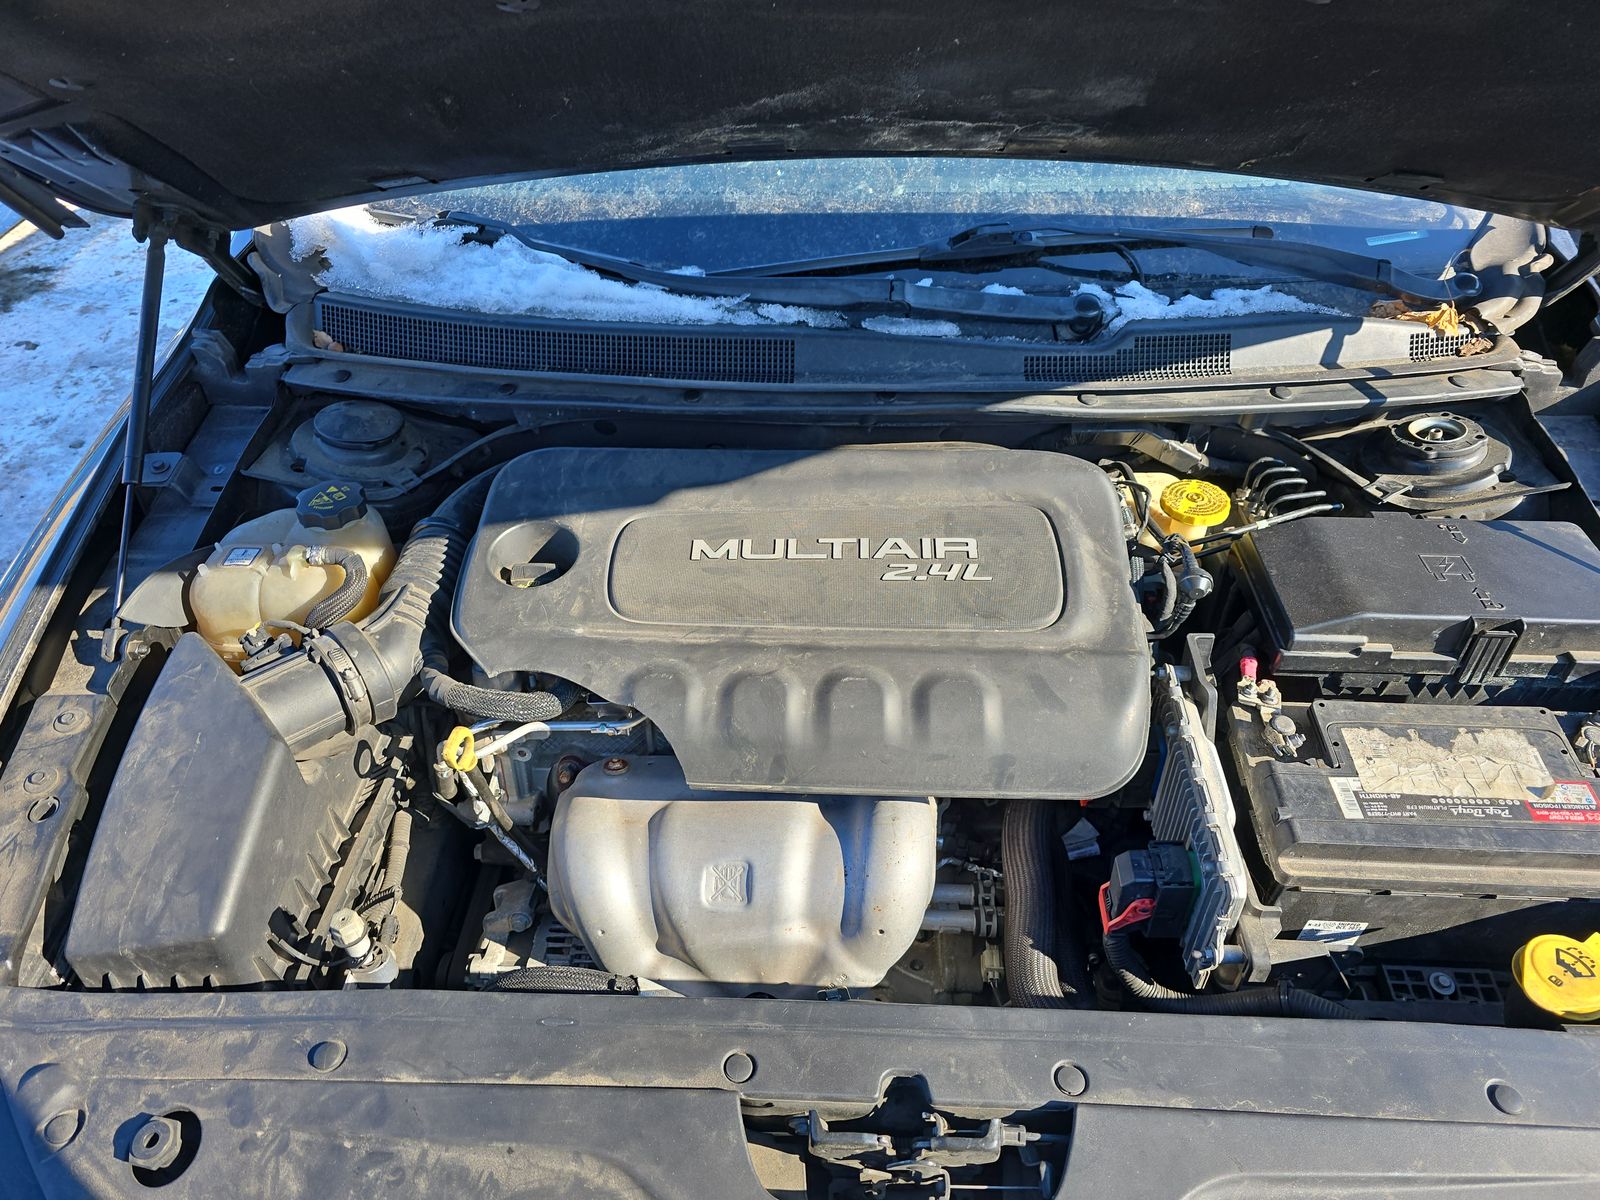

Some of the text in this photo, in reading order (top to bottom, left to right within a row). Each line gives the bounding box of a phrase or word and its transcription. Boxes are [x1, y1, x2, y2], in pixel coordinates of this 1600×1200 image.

[690, 536, 979, 561] MULTIAIR
[881, 562, 993, 582] 2.4L
[1450, 805, 1512, 818] Pep Boys
